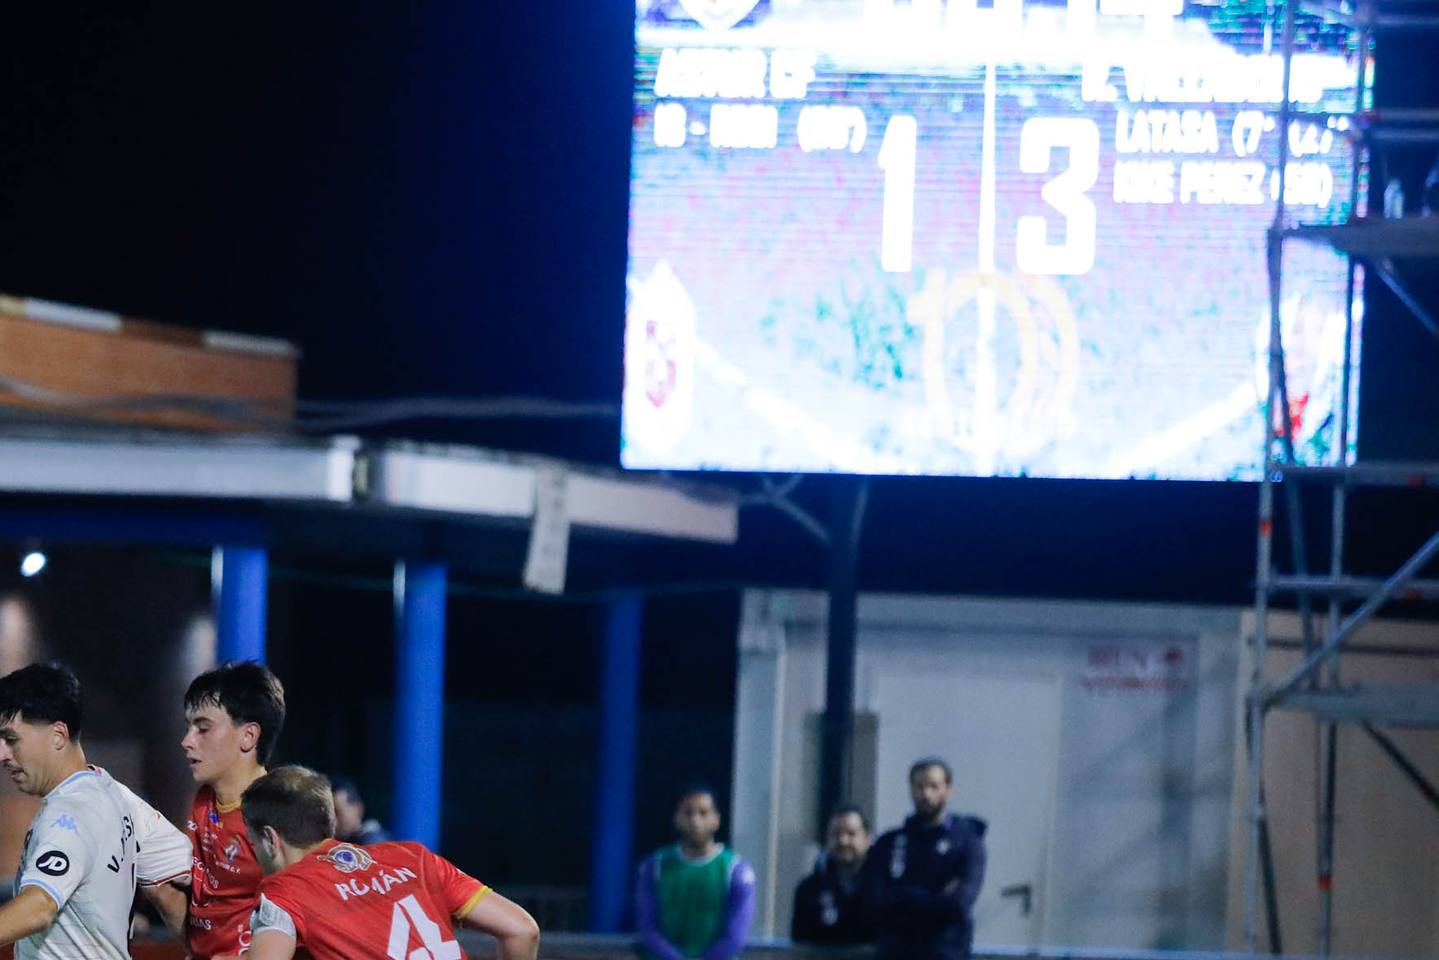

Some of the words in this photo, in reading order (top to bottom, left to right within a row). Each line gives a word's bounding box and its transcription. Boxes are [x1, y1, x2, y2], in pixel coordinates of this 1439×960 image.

[1115, 108, 1219, 154] LATASA
[877, 115, 918, 273] 1
[1017, 117, 1099, 275] 3
[38, 855, 68, 872] JD
